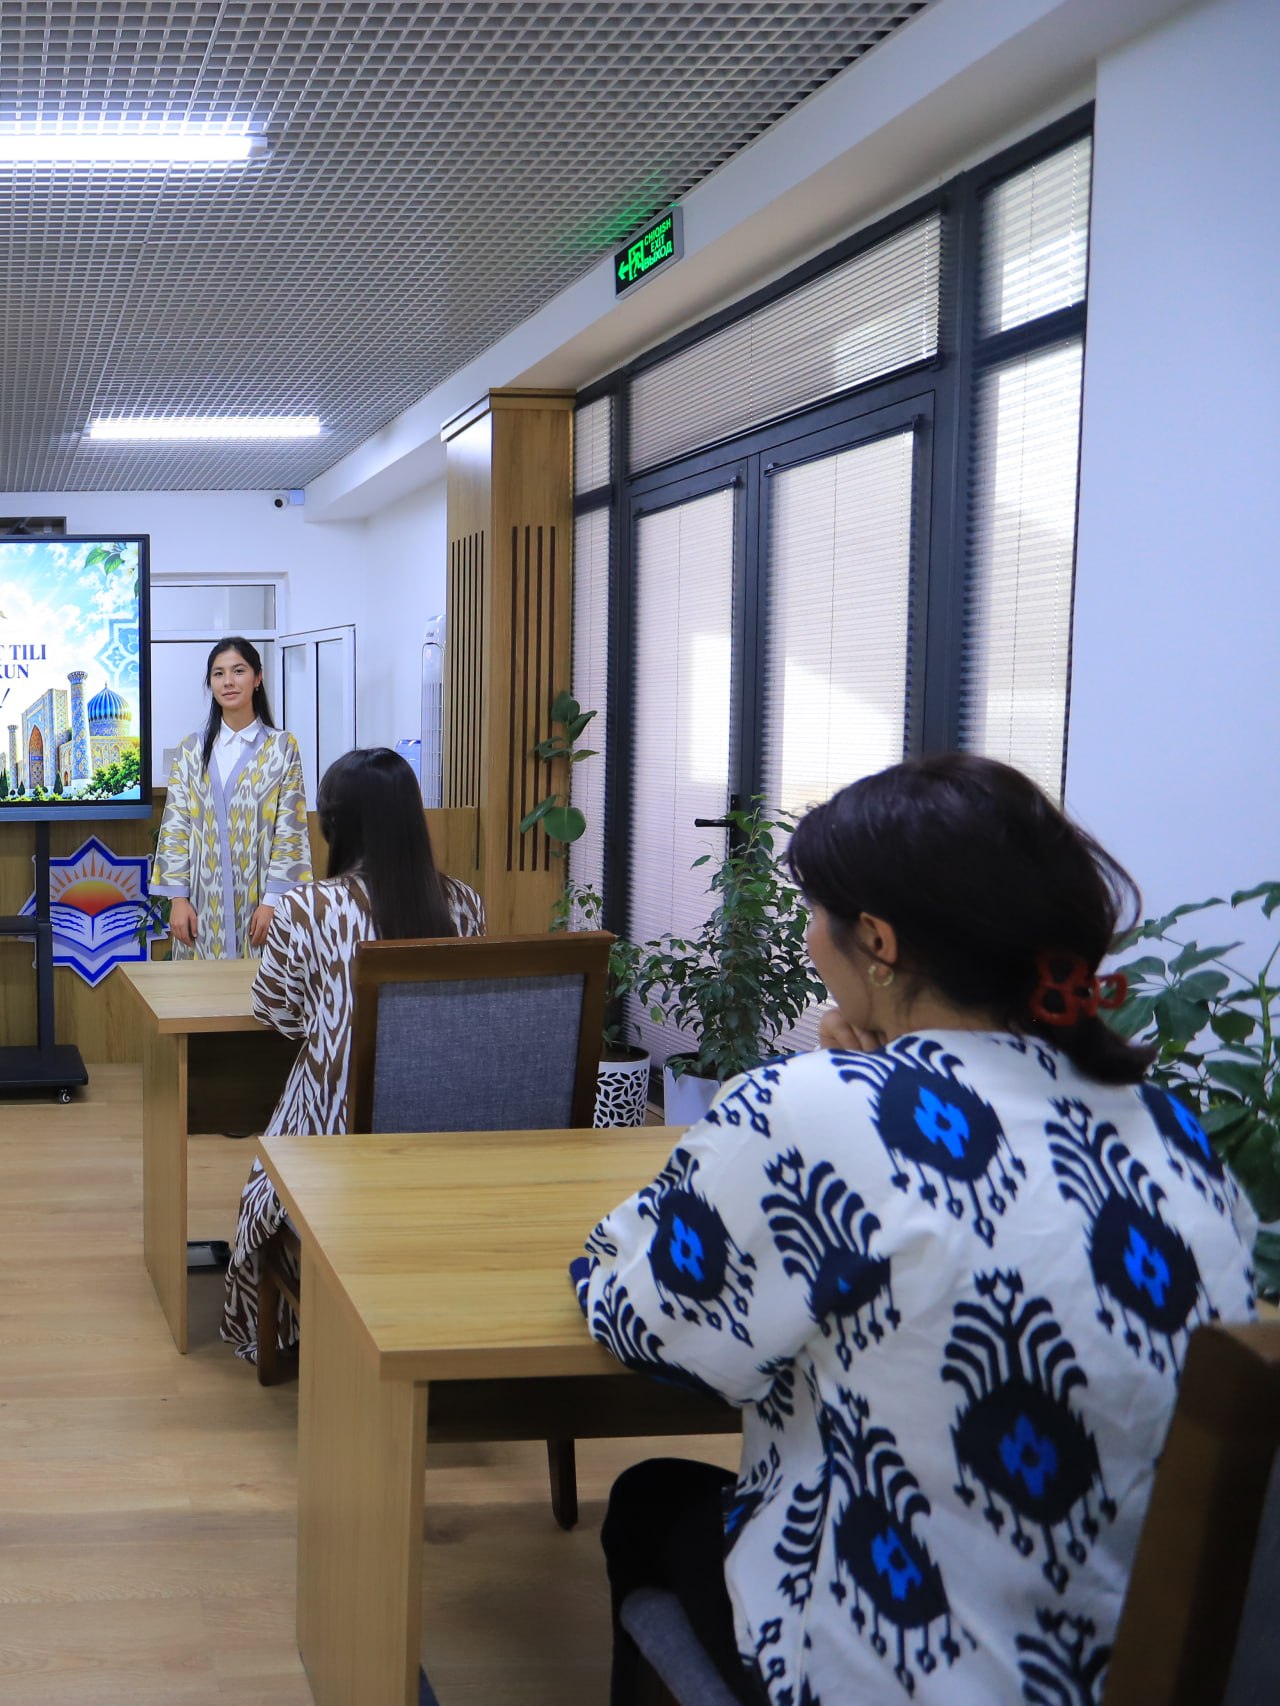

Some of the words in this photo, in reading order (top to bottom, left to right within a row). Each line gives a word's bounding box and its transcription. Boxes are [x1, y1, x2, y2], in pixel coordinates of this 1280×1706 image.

[650, 234, 665, 253] EXIT
[643, 240, 673, 270] ВЫХОД
[8, 643, 47, 660] TILI
